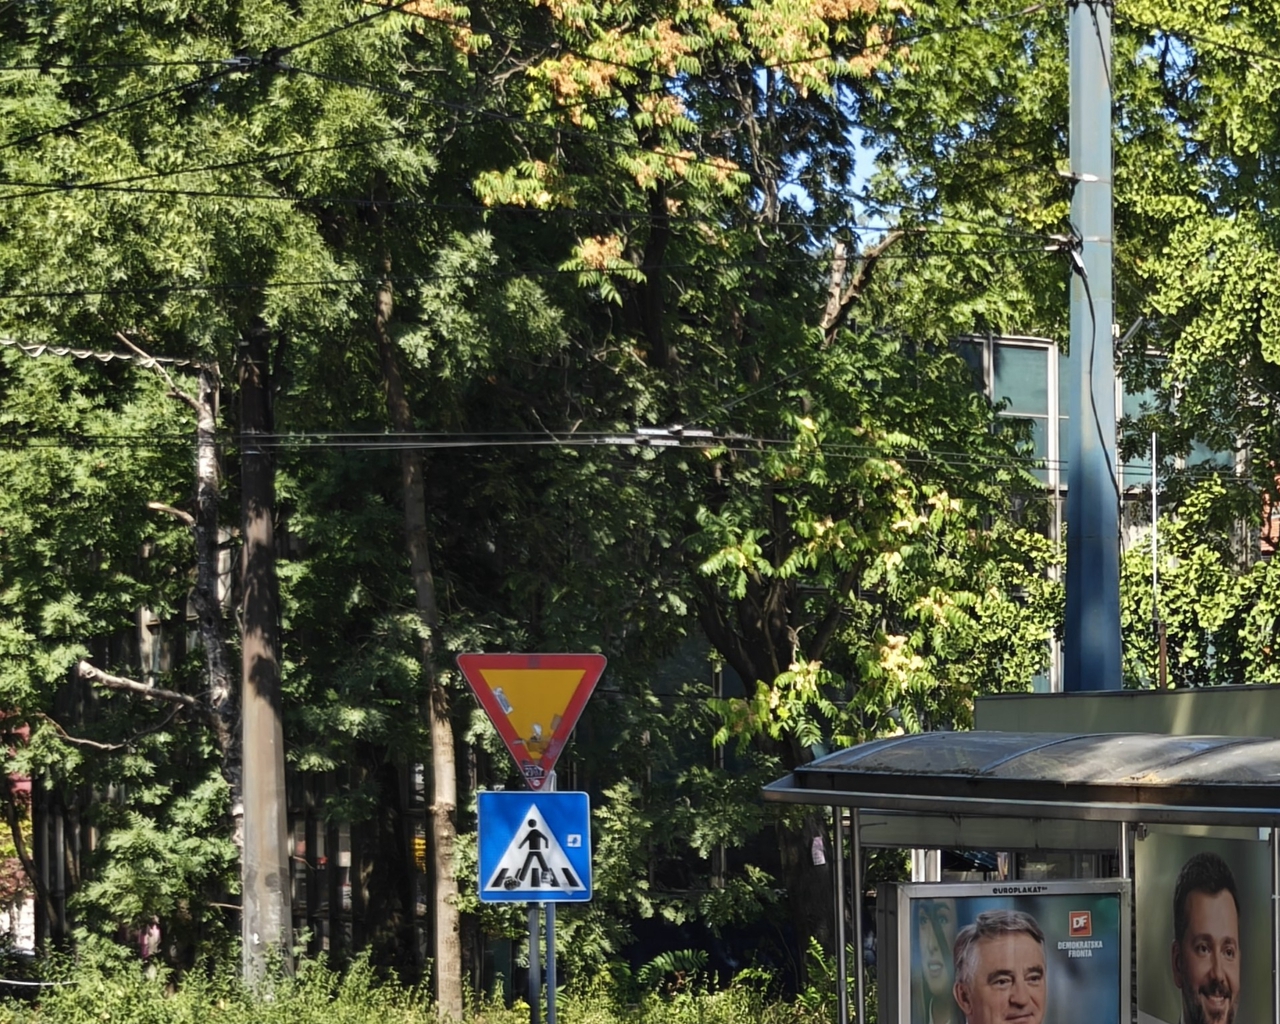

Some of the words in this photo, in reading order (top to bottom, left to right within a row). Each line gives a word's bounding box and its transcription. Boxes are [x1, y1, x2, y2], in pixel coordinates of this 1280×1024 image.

[1073, 916, 1087, 928] DF
[1058, 941, 1103, 949] DEMOKRATSKA
[1068, 949, 1092, 958] FRONTA
